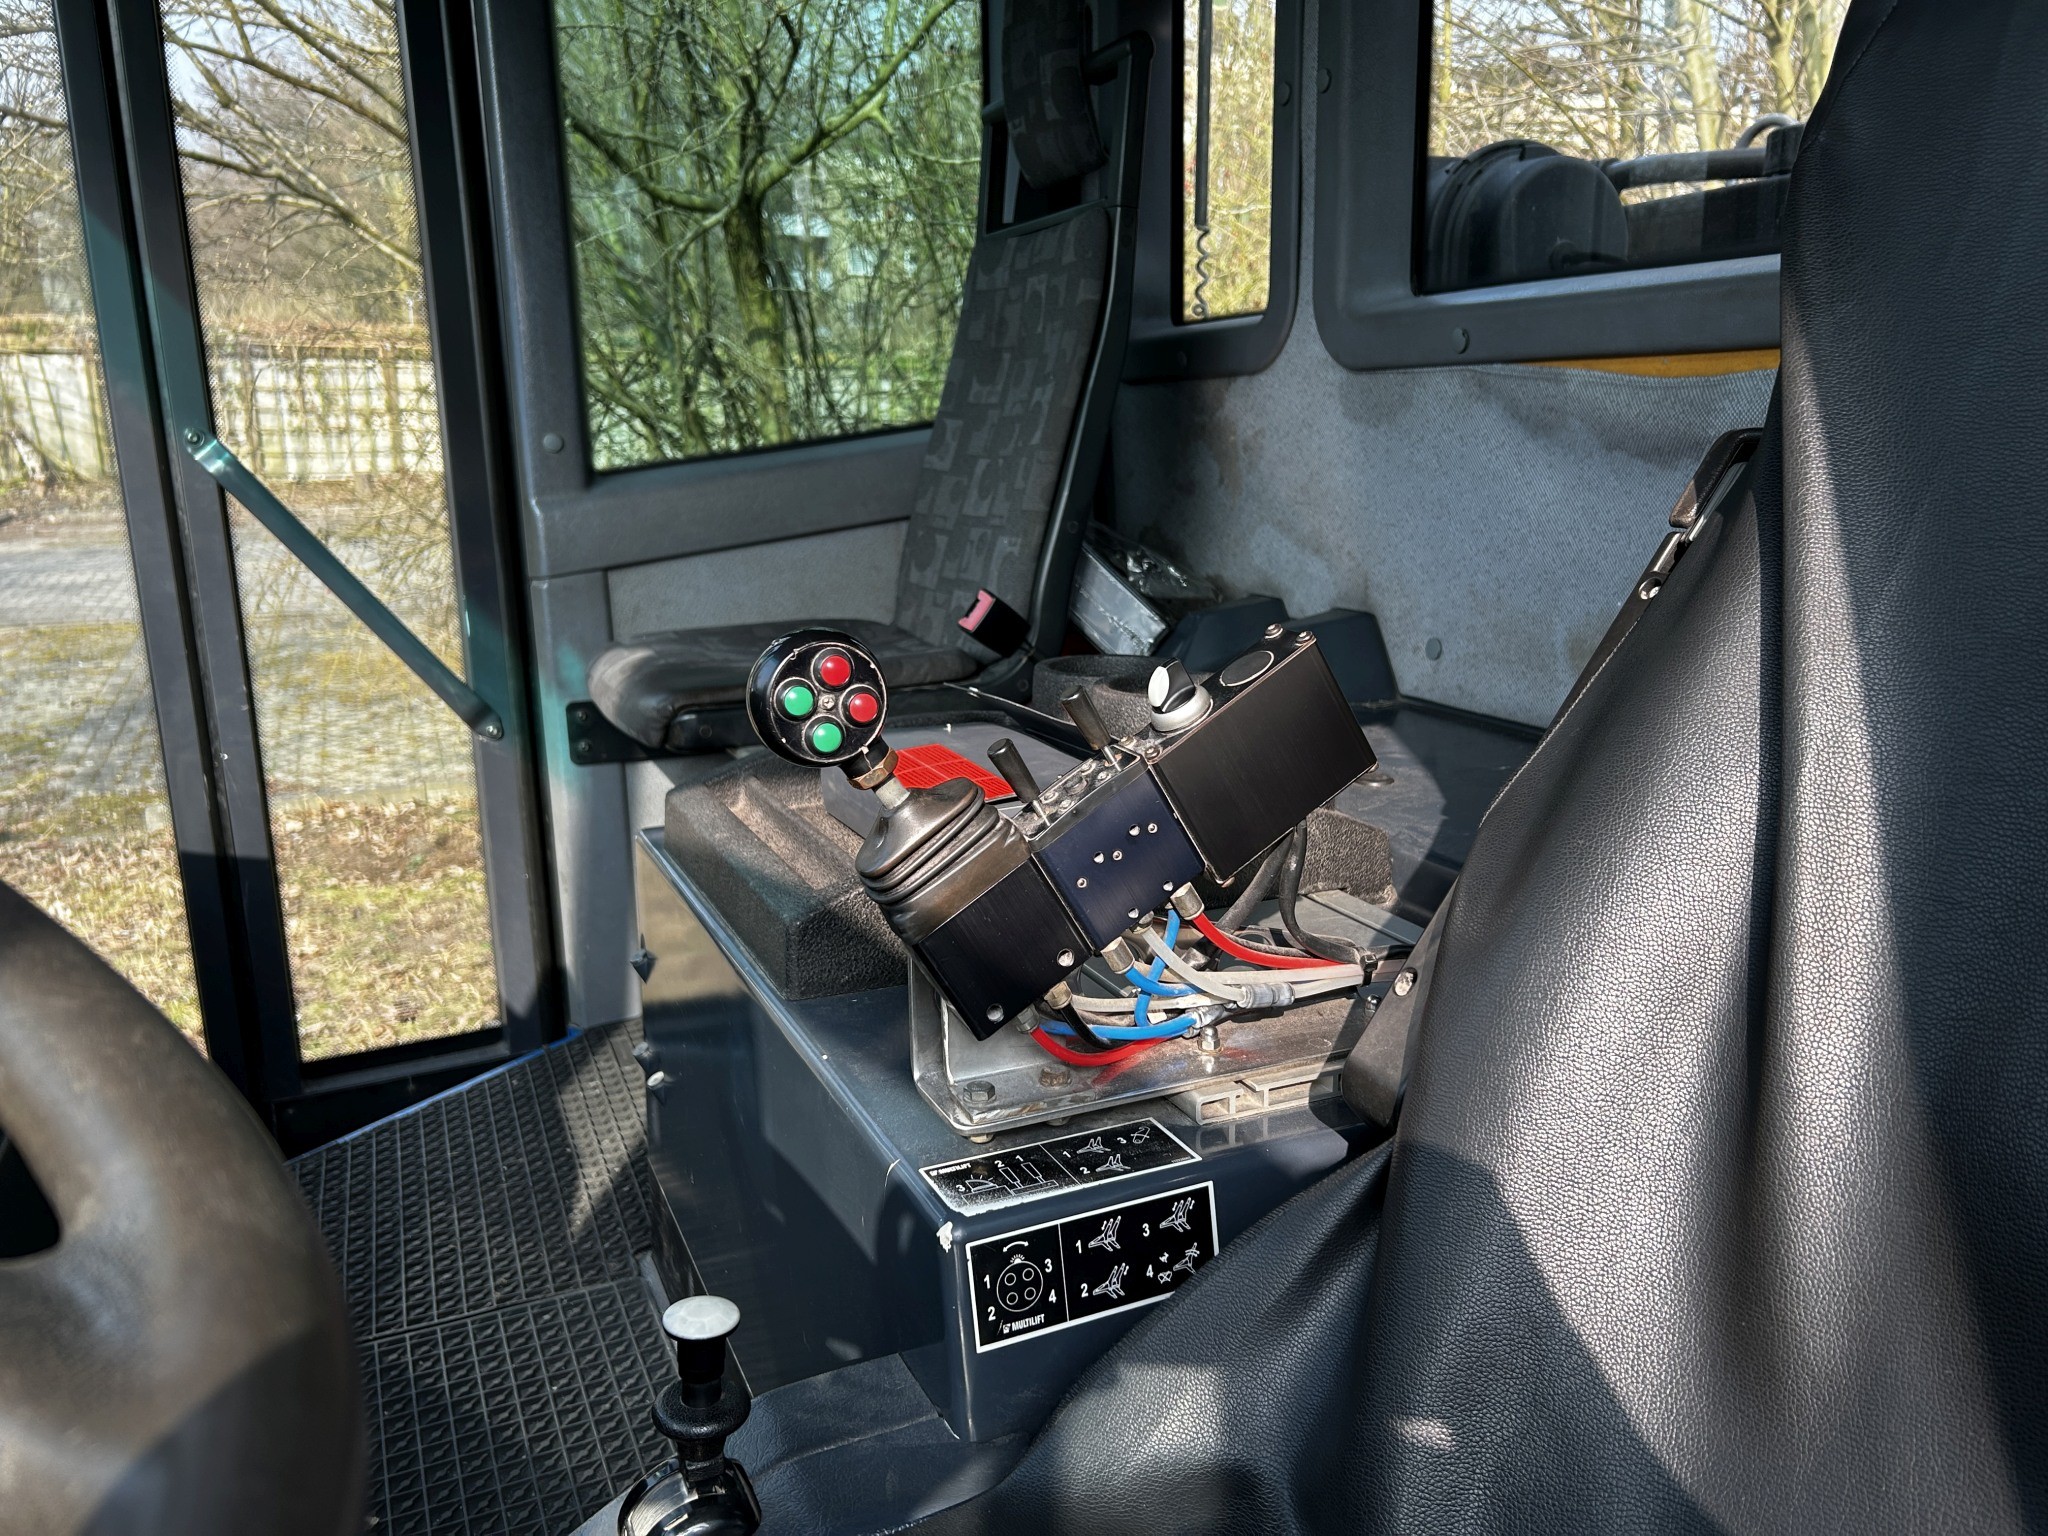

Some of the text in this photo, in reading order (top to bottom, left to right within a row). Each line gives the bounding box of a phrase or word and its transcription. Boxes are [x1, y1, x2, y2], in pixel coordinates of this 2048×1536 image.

[1063, 1150, 1072, 1159] 1
[994, 1160, 1005, 1168] 2
[1079, 1166, 1091, 1175] 2
[955, 1184, 966, 1192] 3
[1142, 1223, 1150, 1237] 3
[1075, 1239, 1082, 1254] 1
[1044, 1258, 1053, 1273] 3
[1146, 1264, 1154, 1278] 4
[983, 1274, 991, 1289] 1
[1048, 1288, 1057, 1304] 4
[1080, 1283, 1089, 1298] 2
[987, 1306, 997, 1321] 2
[1011, 1313, 1045, 1331] MULTILIFT
